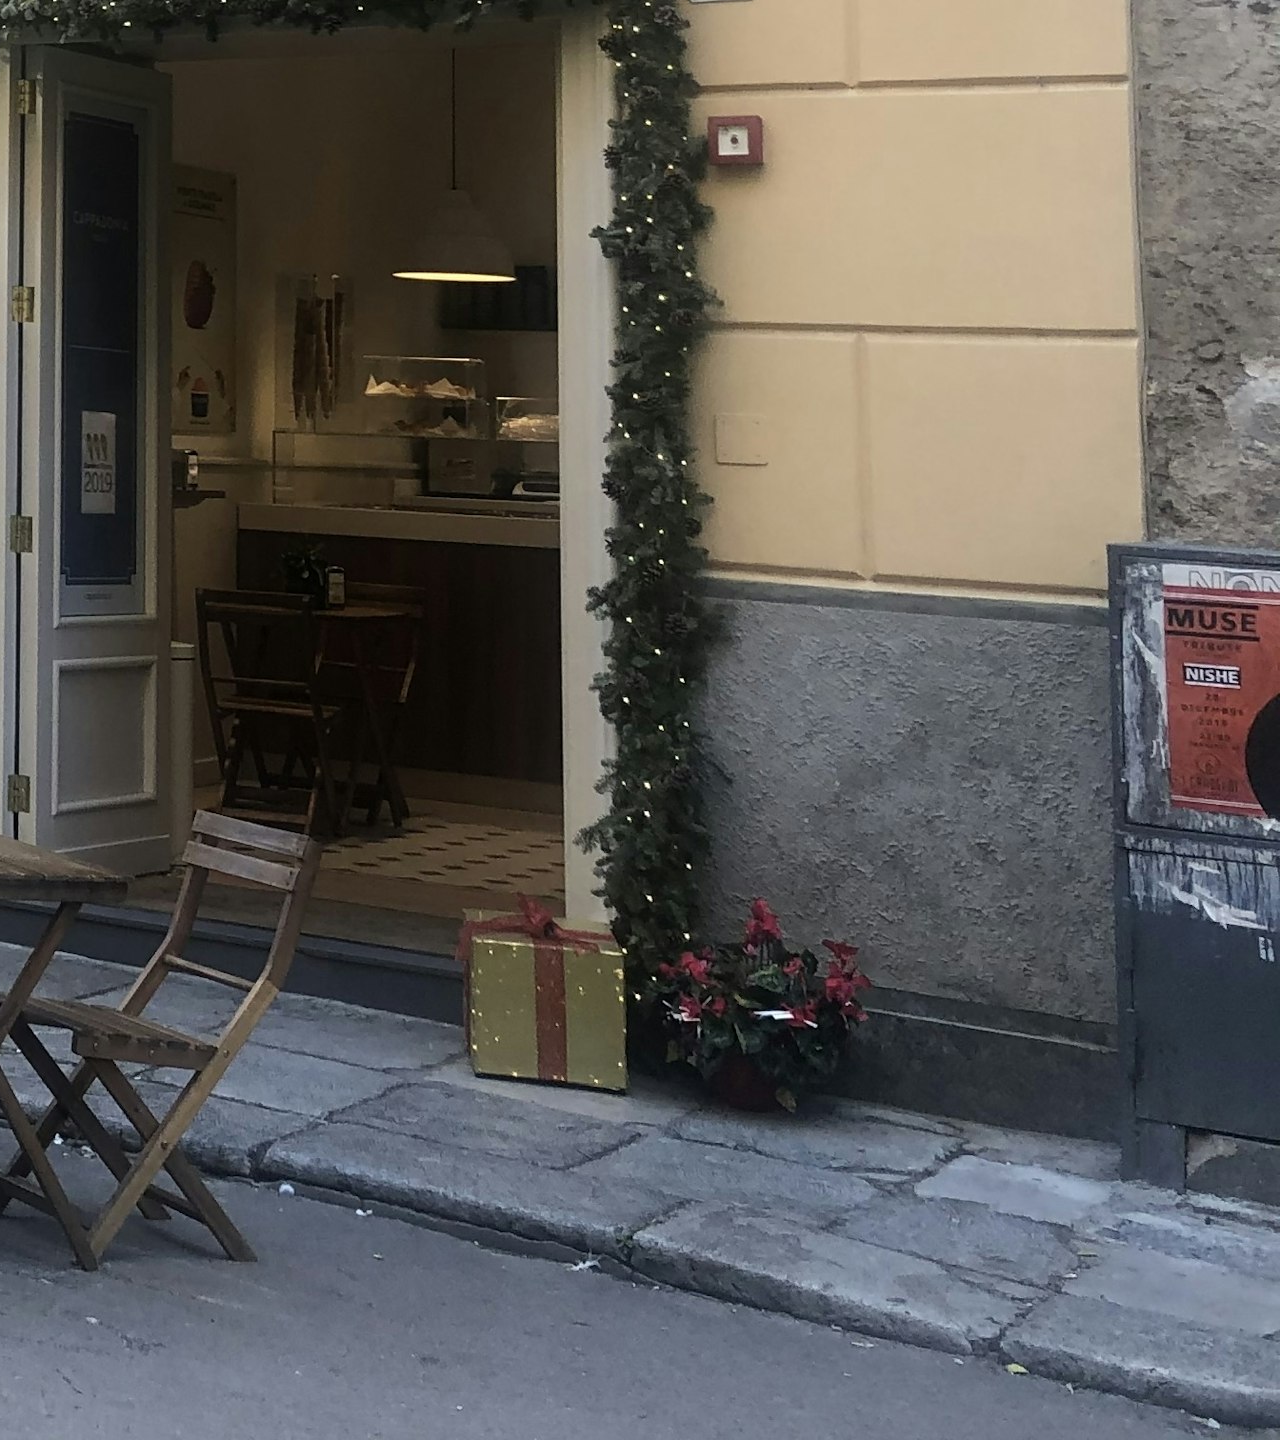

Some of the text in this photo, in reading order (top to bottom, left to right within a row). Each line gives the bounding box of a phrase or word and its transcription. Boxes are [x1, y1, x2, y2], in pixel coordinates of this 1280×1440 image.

[84, 471, 113, 493] 2019
[1167, 607, 1257, 633] MUSE
[1183, 640, 1242, 652] TRIBUTE
[1185, 667, 1240, 684] NISHE
